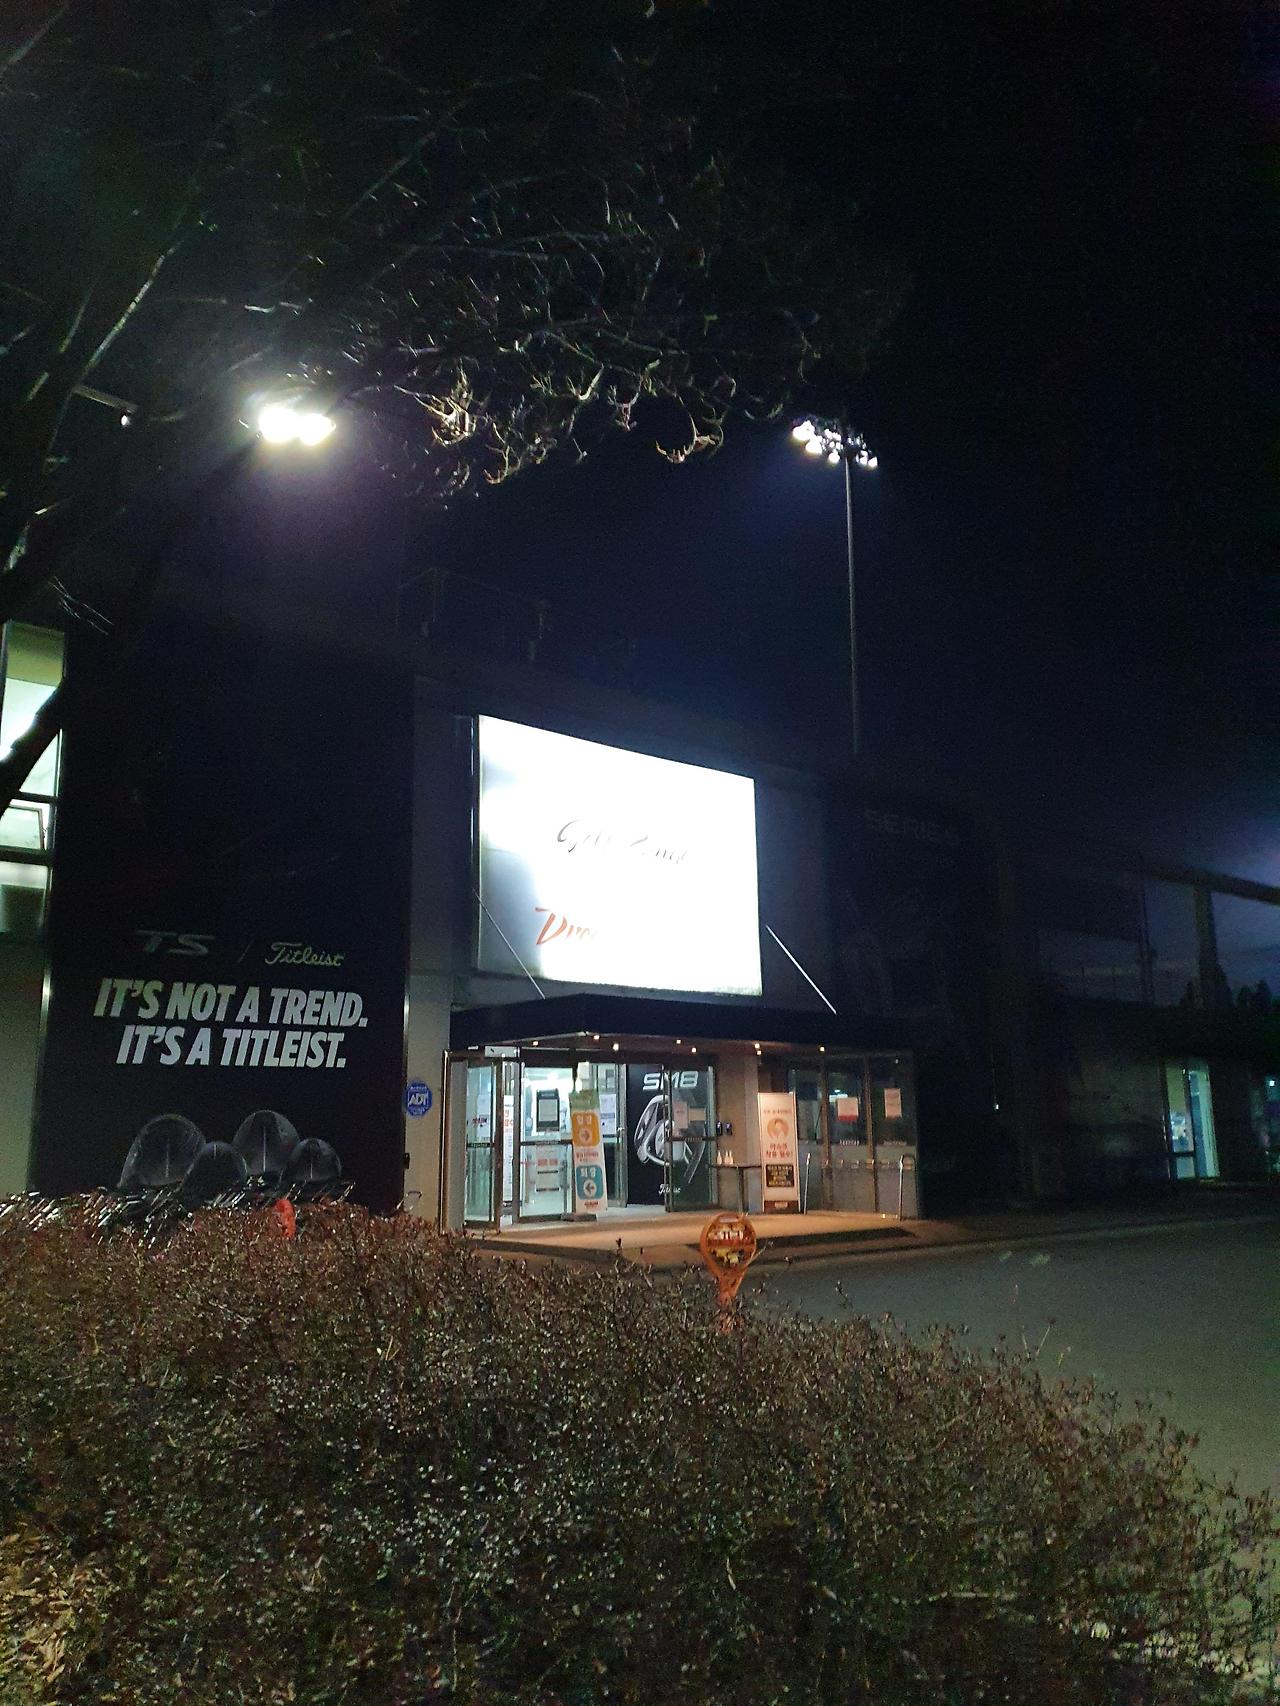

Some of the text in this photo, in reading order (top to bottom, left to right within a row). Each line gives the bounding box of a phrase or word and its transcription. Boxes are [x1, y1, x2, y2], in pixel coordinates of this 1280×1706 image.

[135, 929, 346, 968] TS Titleist
[93, 978, 369, 1028] IT'S NOT A TREND.
[115, 1024, 347, 1069] IT'S A TITLEIST.
